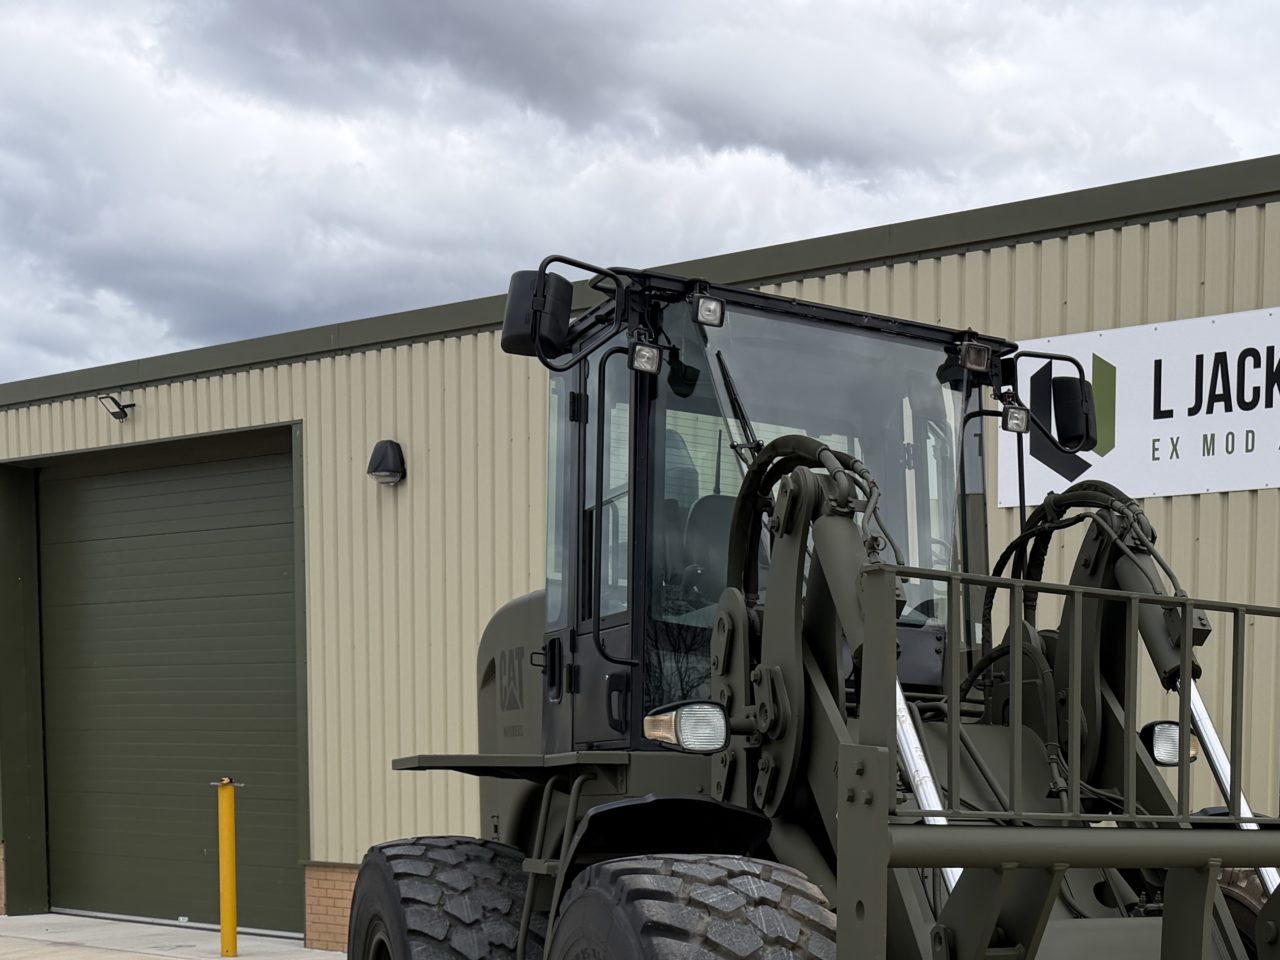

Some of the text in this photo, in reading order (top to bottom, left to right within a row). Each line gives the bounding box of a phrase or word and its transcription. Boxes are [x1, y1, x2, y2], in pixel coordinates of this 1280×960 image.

[1152, 358, 1175, 421] L
[1151, 436, 1180, 462] EX
[1202, 428, 1256, 457] MOD
[499, 646, 525, 713] CAT
